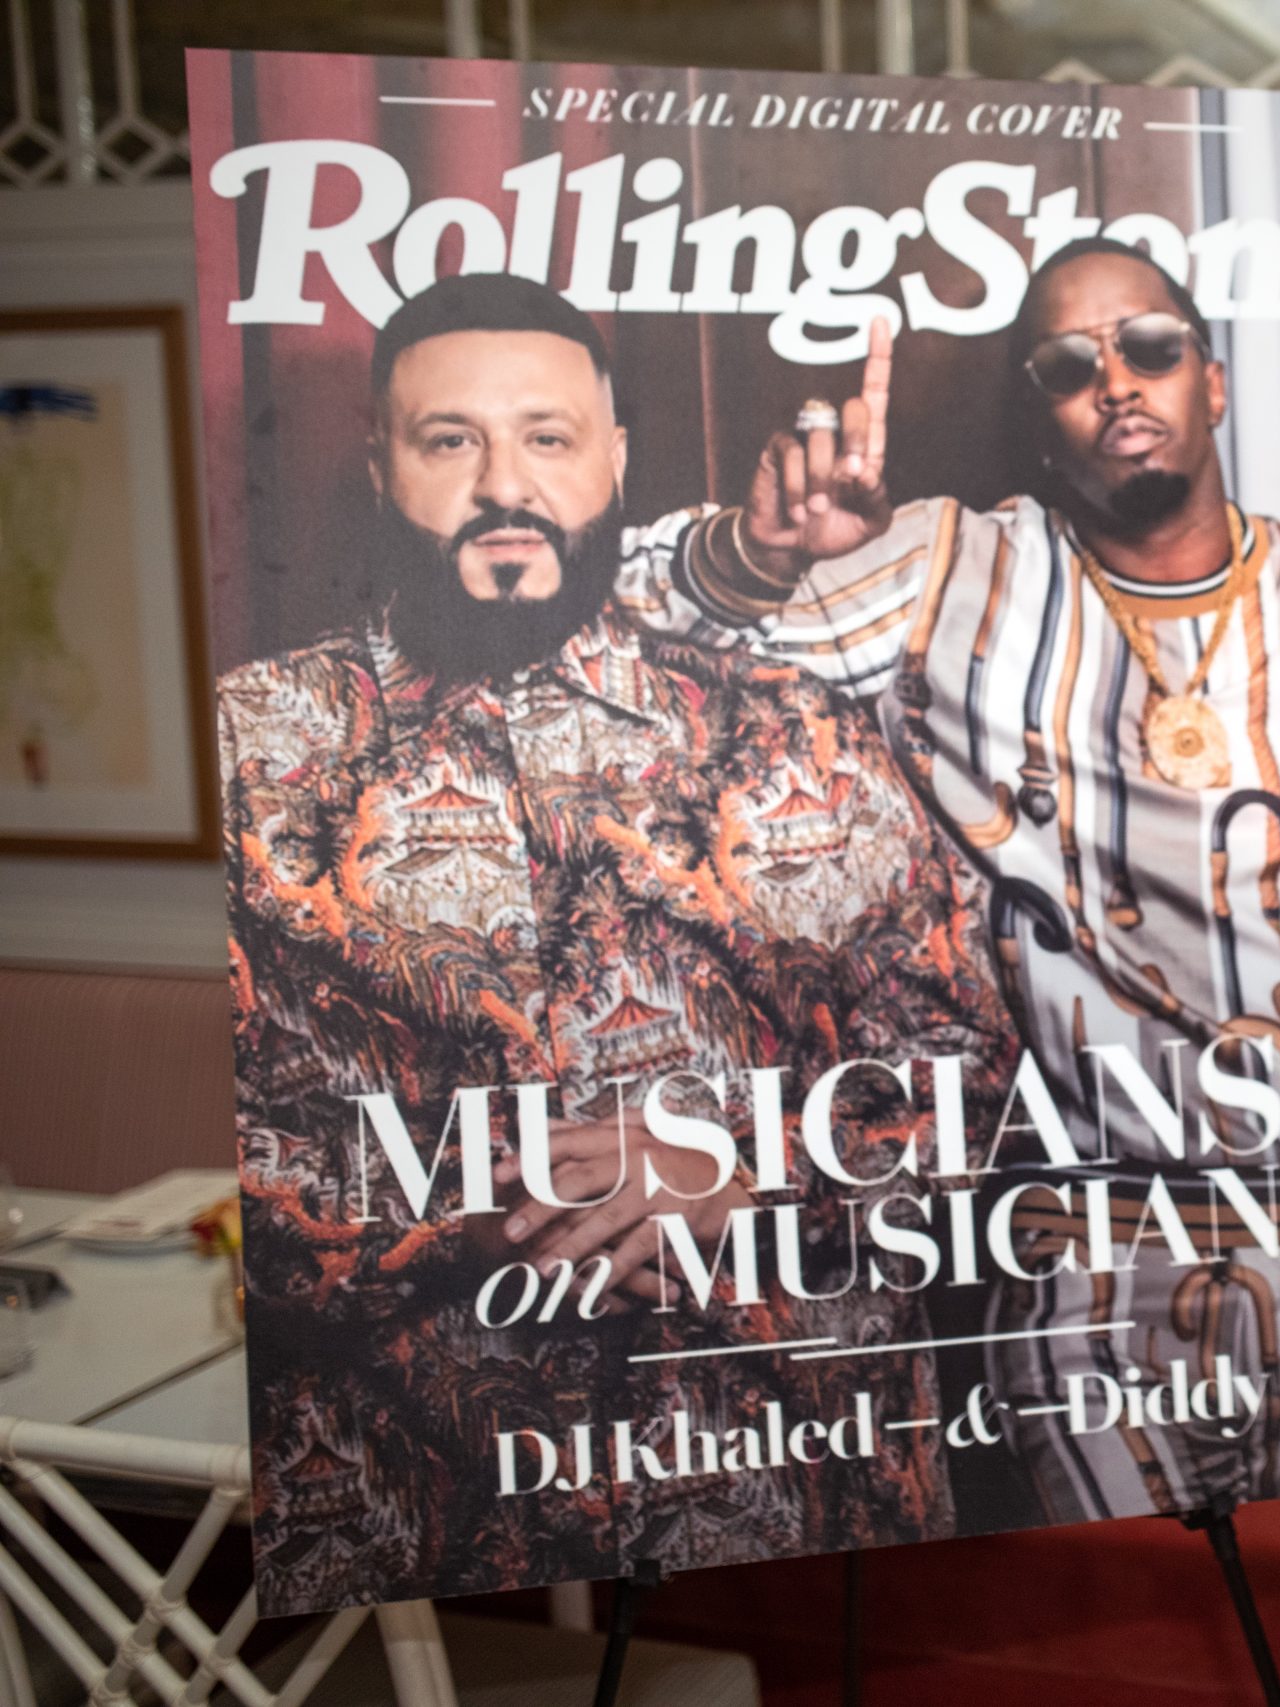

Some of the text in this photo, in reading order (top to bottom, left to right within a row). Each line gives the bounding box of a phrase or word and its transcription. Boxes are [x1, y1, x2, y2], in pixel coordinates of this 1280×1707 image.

[523, 86, 1124, 140] SPECIAL DIGITAL COVER
[474, 1255, 611, 1329] on
[492, 1424, 596, 1497] DJ
[610, 1392, 877, 1486] Khaled
